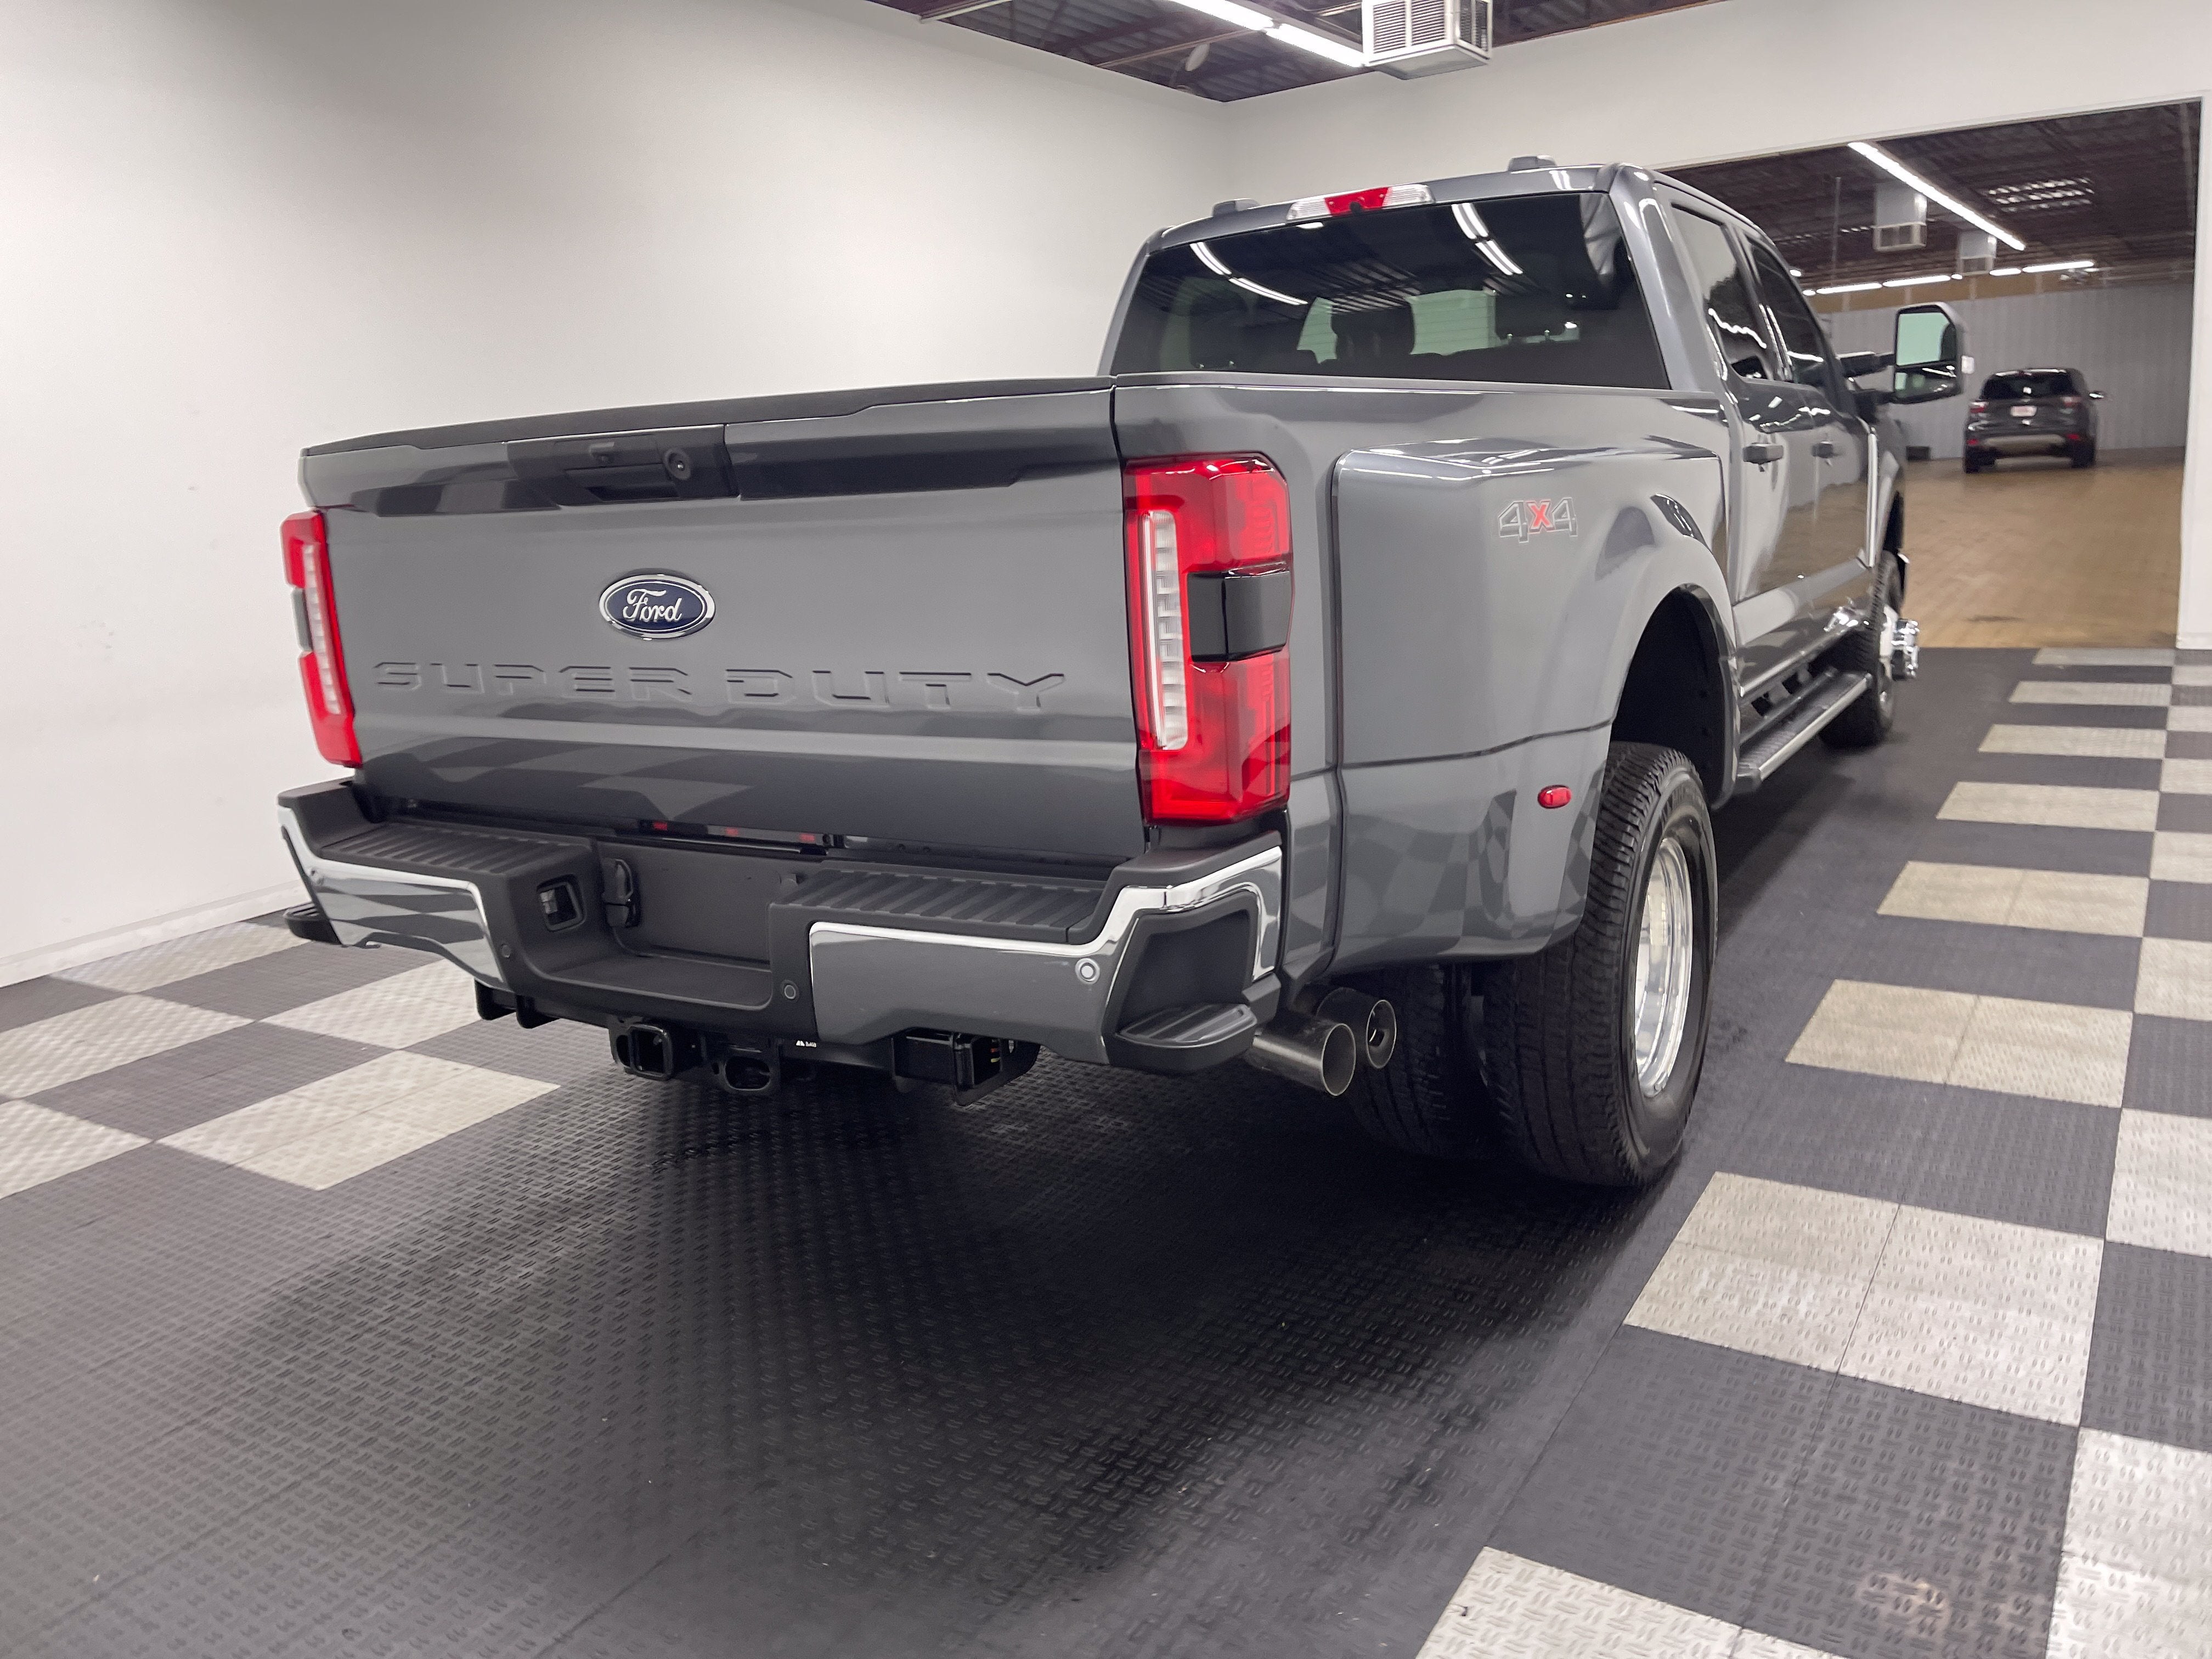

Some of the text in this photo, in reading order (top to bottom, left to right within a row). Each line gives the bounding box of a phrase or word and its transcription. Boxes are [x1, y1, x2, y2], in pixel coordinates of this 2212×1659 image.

[622, 588, 682, 623] Ford
[372, 662, 1066, 712] SUPER DUTY
